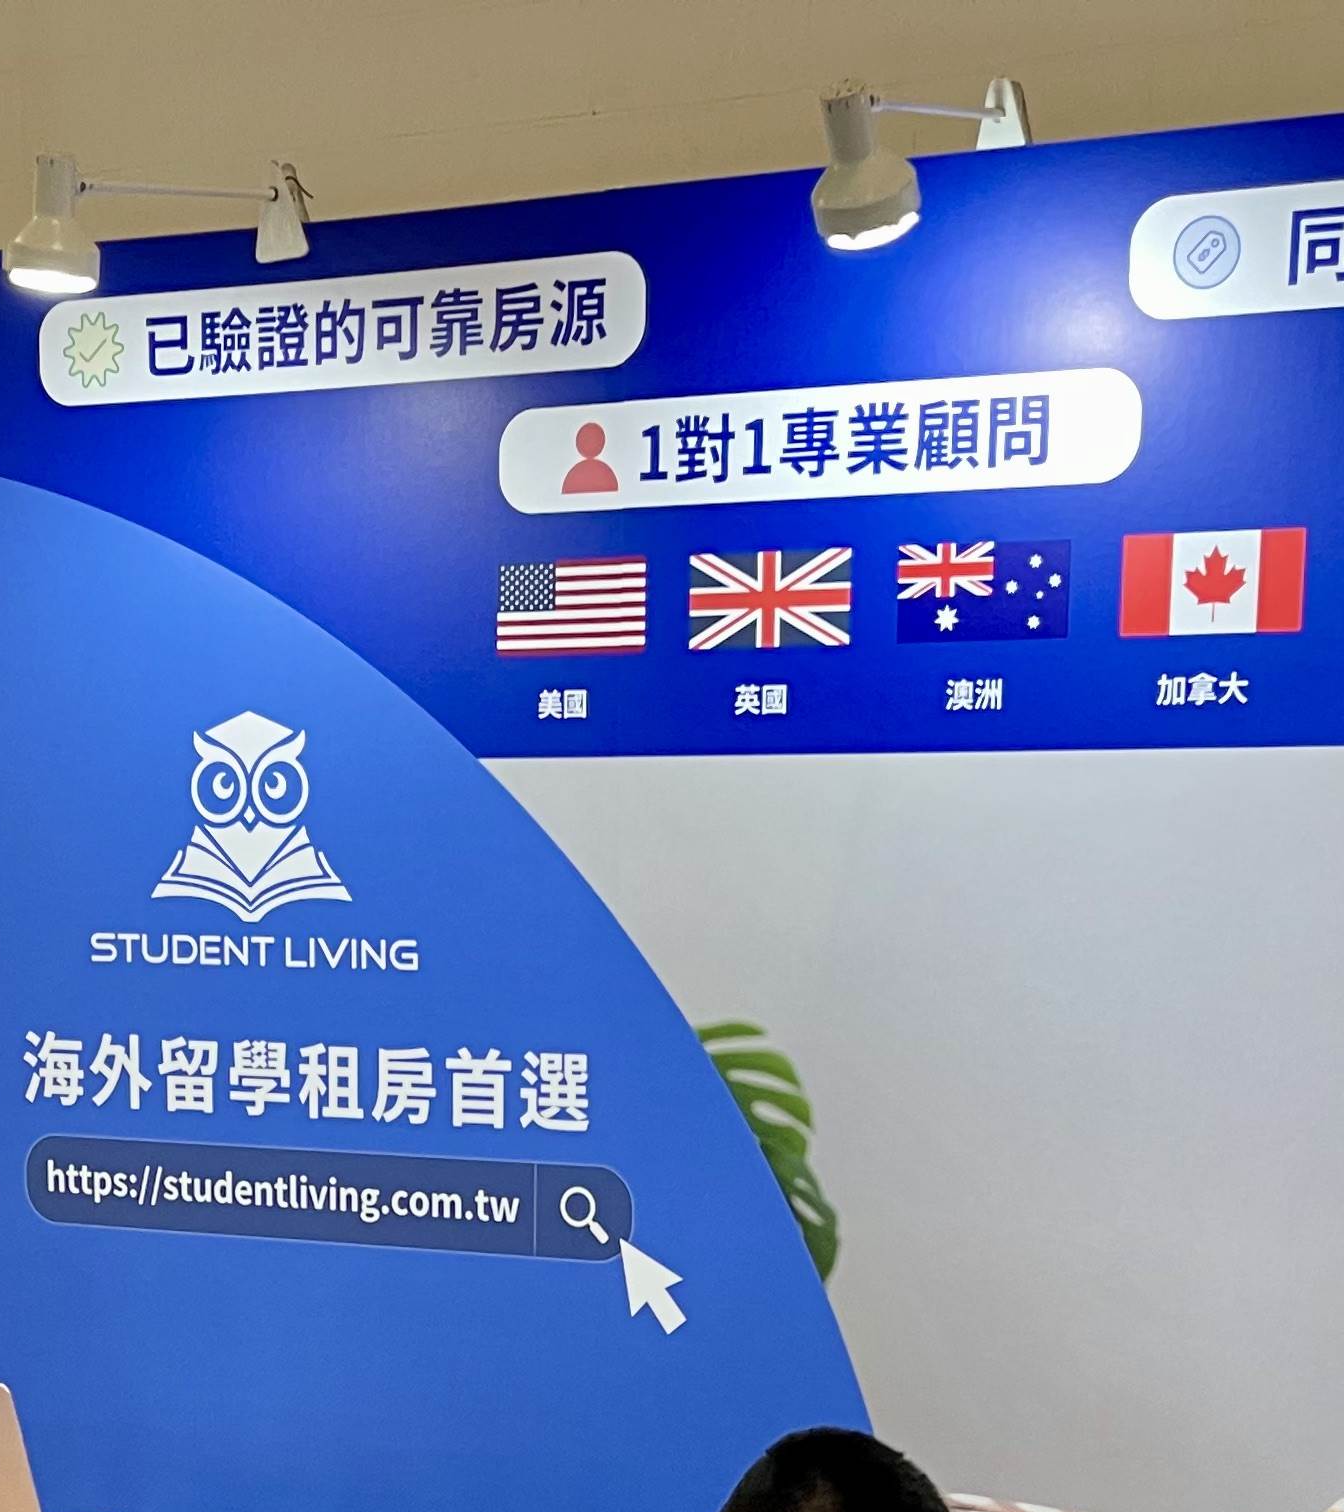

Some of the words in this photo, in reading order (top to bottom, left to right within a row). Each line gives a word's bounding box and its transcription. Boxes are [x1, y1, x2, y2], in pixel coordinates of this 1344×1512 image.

[144, 276, 608, 377] 已驗證的可靠房源
[638, 394, 1050, 484] 1對1專業顧問
[538, 688, 588, 720] 美國
[734, 683, 788, 716] 英國
[945, 678, 1003, 712] 澳洲
[1156, 672, 1249, 708] 加拿大
[90, 932, 275, 968] STUDENT
[285, 937, 419, 972] LIVING
[22, 1030, 591, 1132] 海外留學租房首選
[46, 1159, 520, 1224] https://studentliving.com.tw
